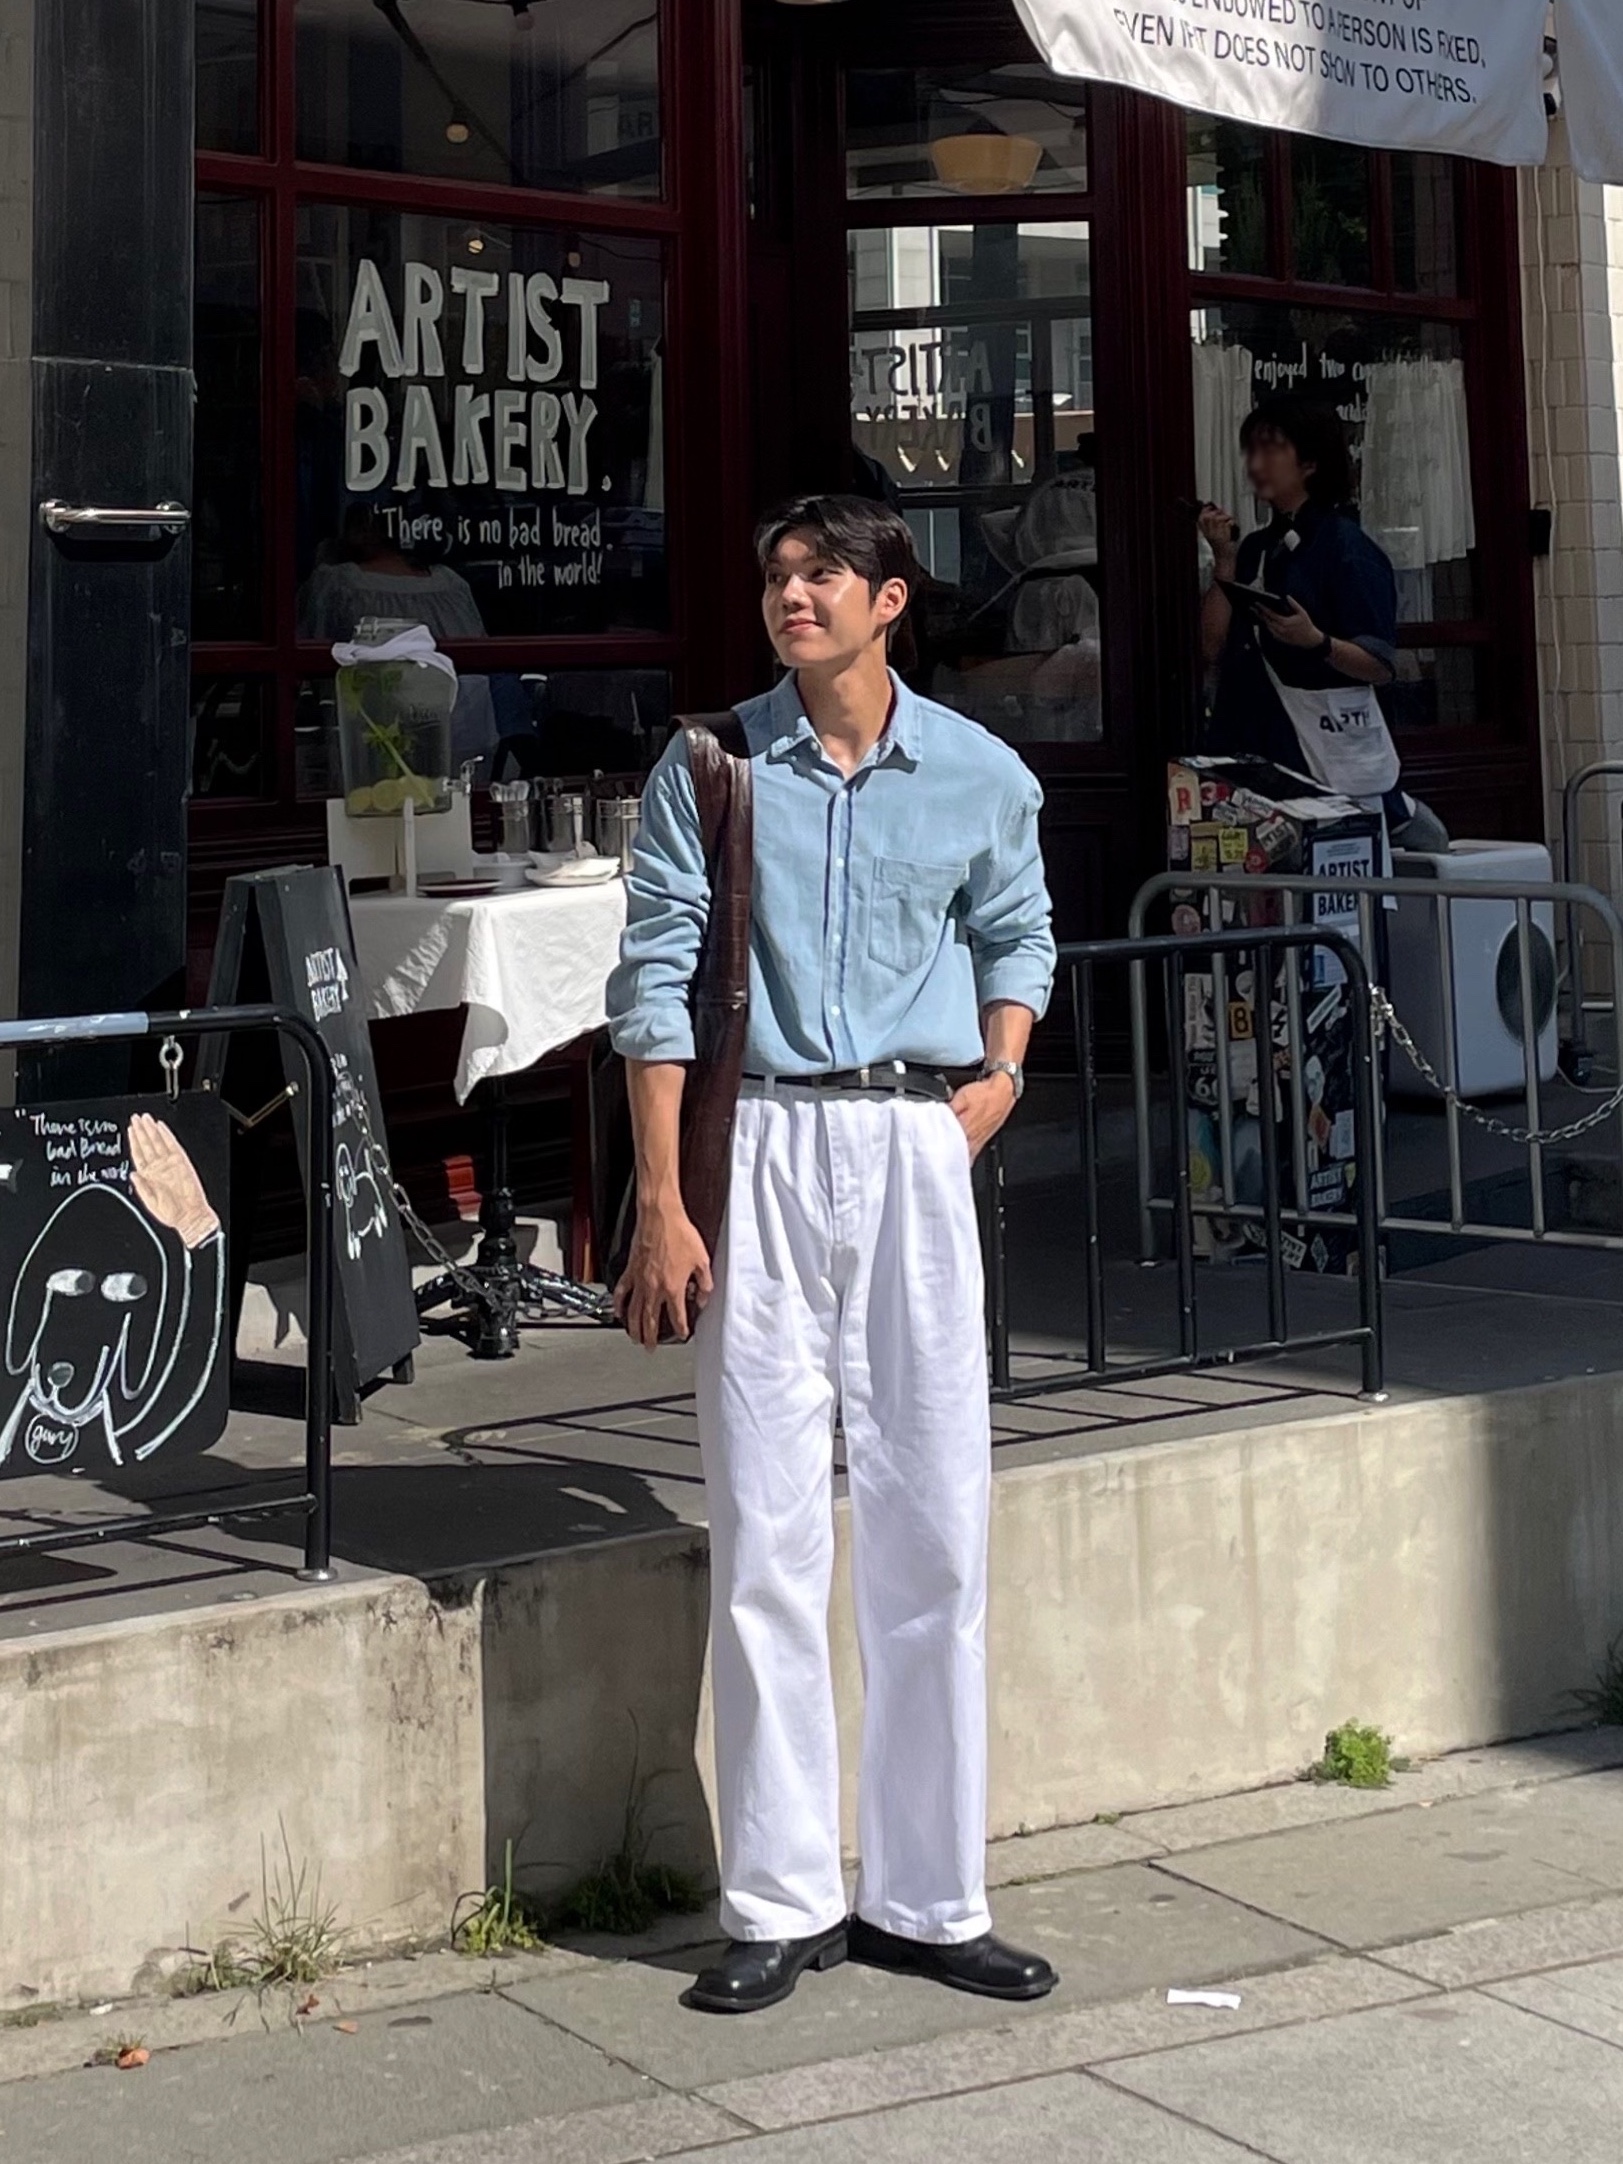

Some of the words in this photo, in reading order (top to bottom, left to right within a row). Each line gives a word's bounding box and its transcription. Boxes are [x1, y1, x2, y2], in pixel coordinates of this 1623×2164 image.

[1113, 8, 1174, 46] EVEN
[1214, 30, 1270, 66] DOES
[1274, 41, 1316, 75] NOT
[1360, 63, 1389, 92] TO
[1300, 1, 1325, 30] TO
[1412, 26, 1433, 53] IS
[338, 258, 610, 390] ARTIST
[1254, 341, 1308, 390] enjoyed
[344, 384, 613, 496] BAKERY.
[458, 516, 471, 545] is
[479, 520, 502, 545] no
[509, 505, 541, 549] bad
[498, 560, 512, 589] in
[518, 555, 546, 588] the
[50, 1165, 72, 1188] in
